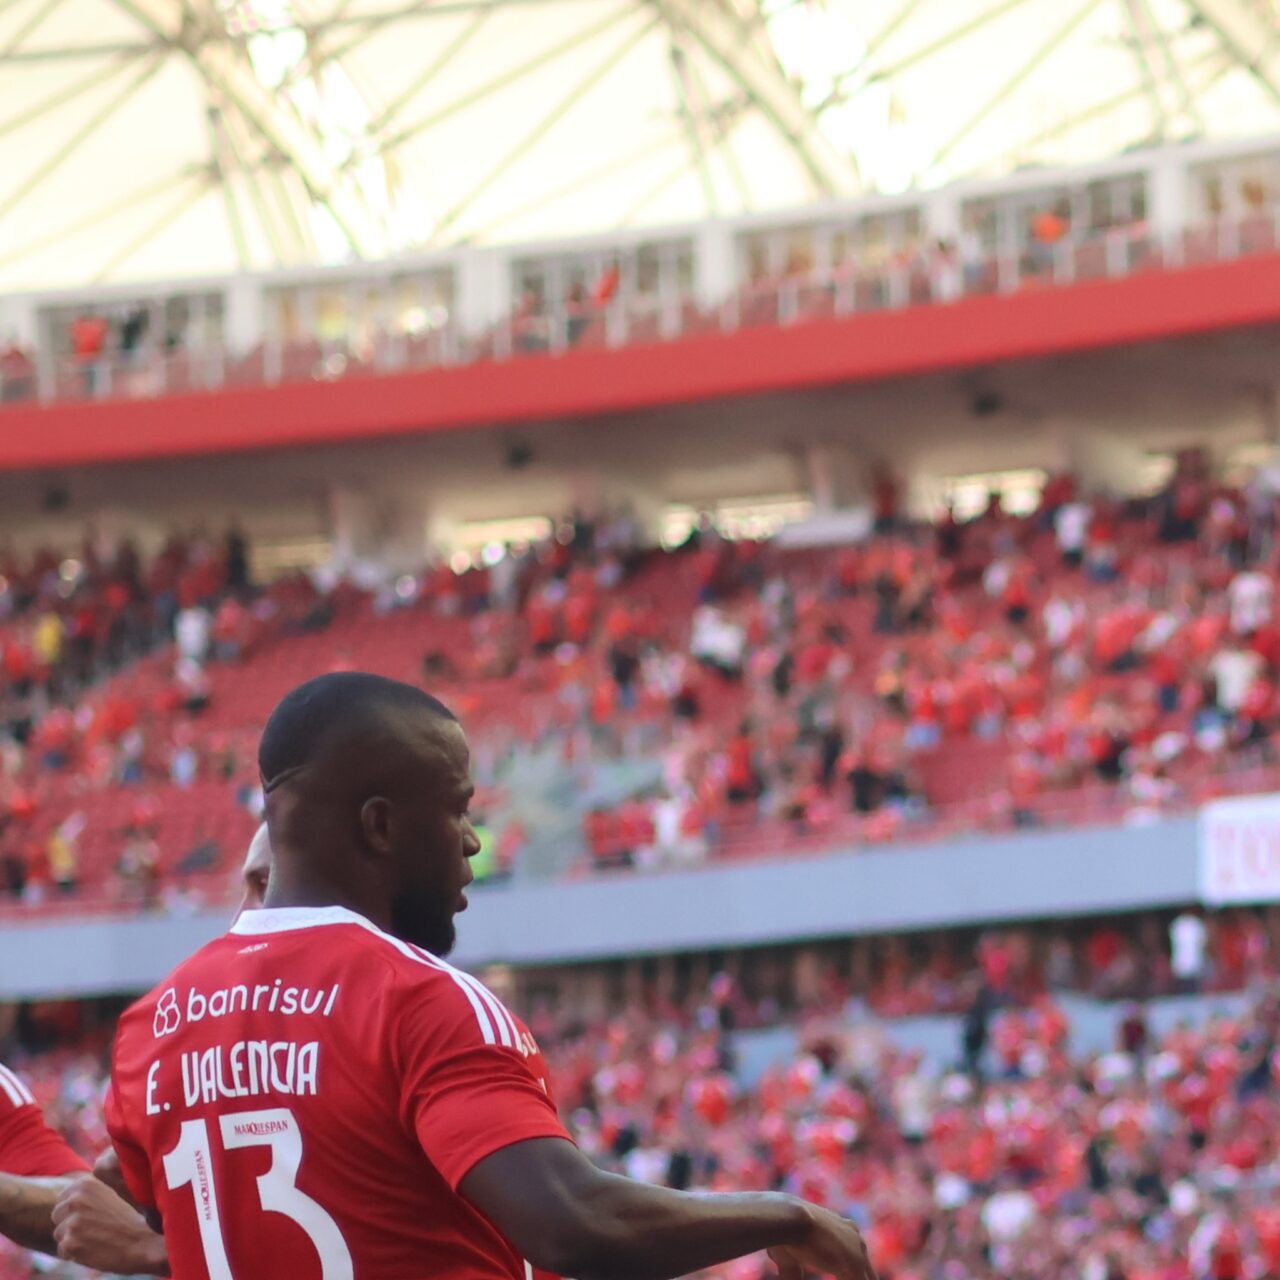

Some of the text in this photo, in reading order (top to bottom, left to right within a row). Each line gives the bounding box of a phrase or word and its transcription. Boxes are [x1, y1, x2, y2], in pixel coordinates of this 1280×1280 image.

[187, 978, 339, 1022] banrisul
[146, 1040, 319, 1115] E. VALENCIA
